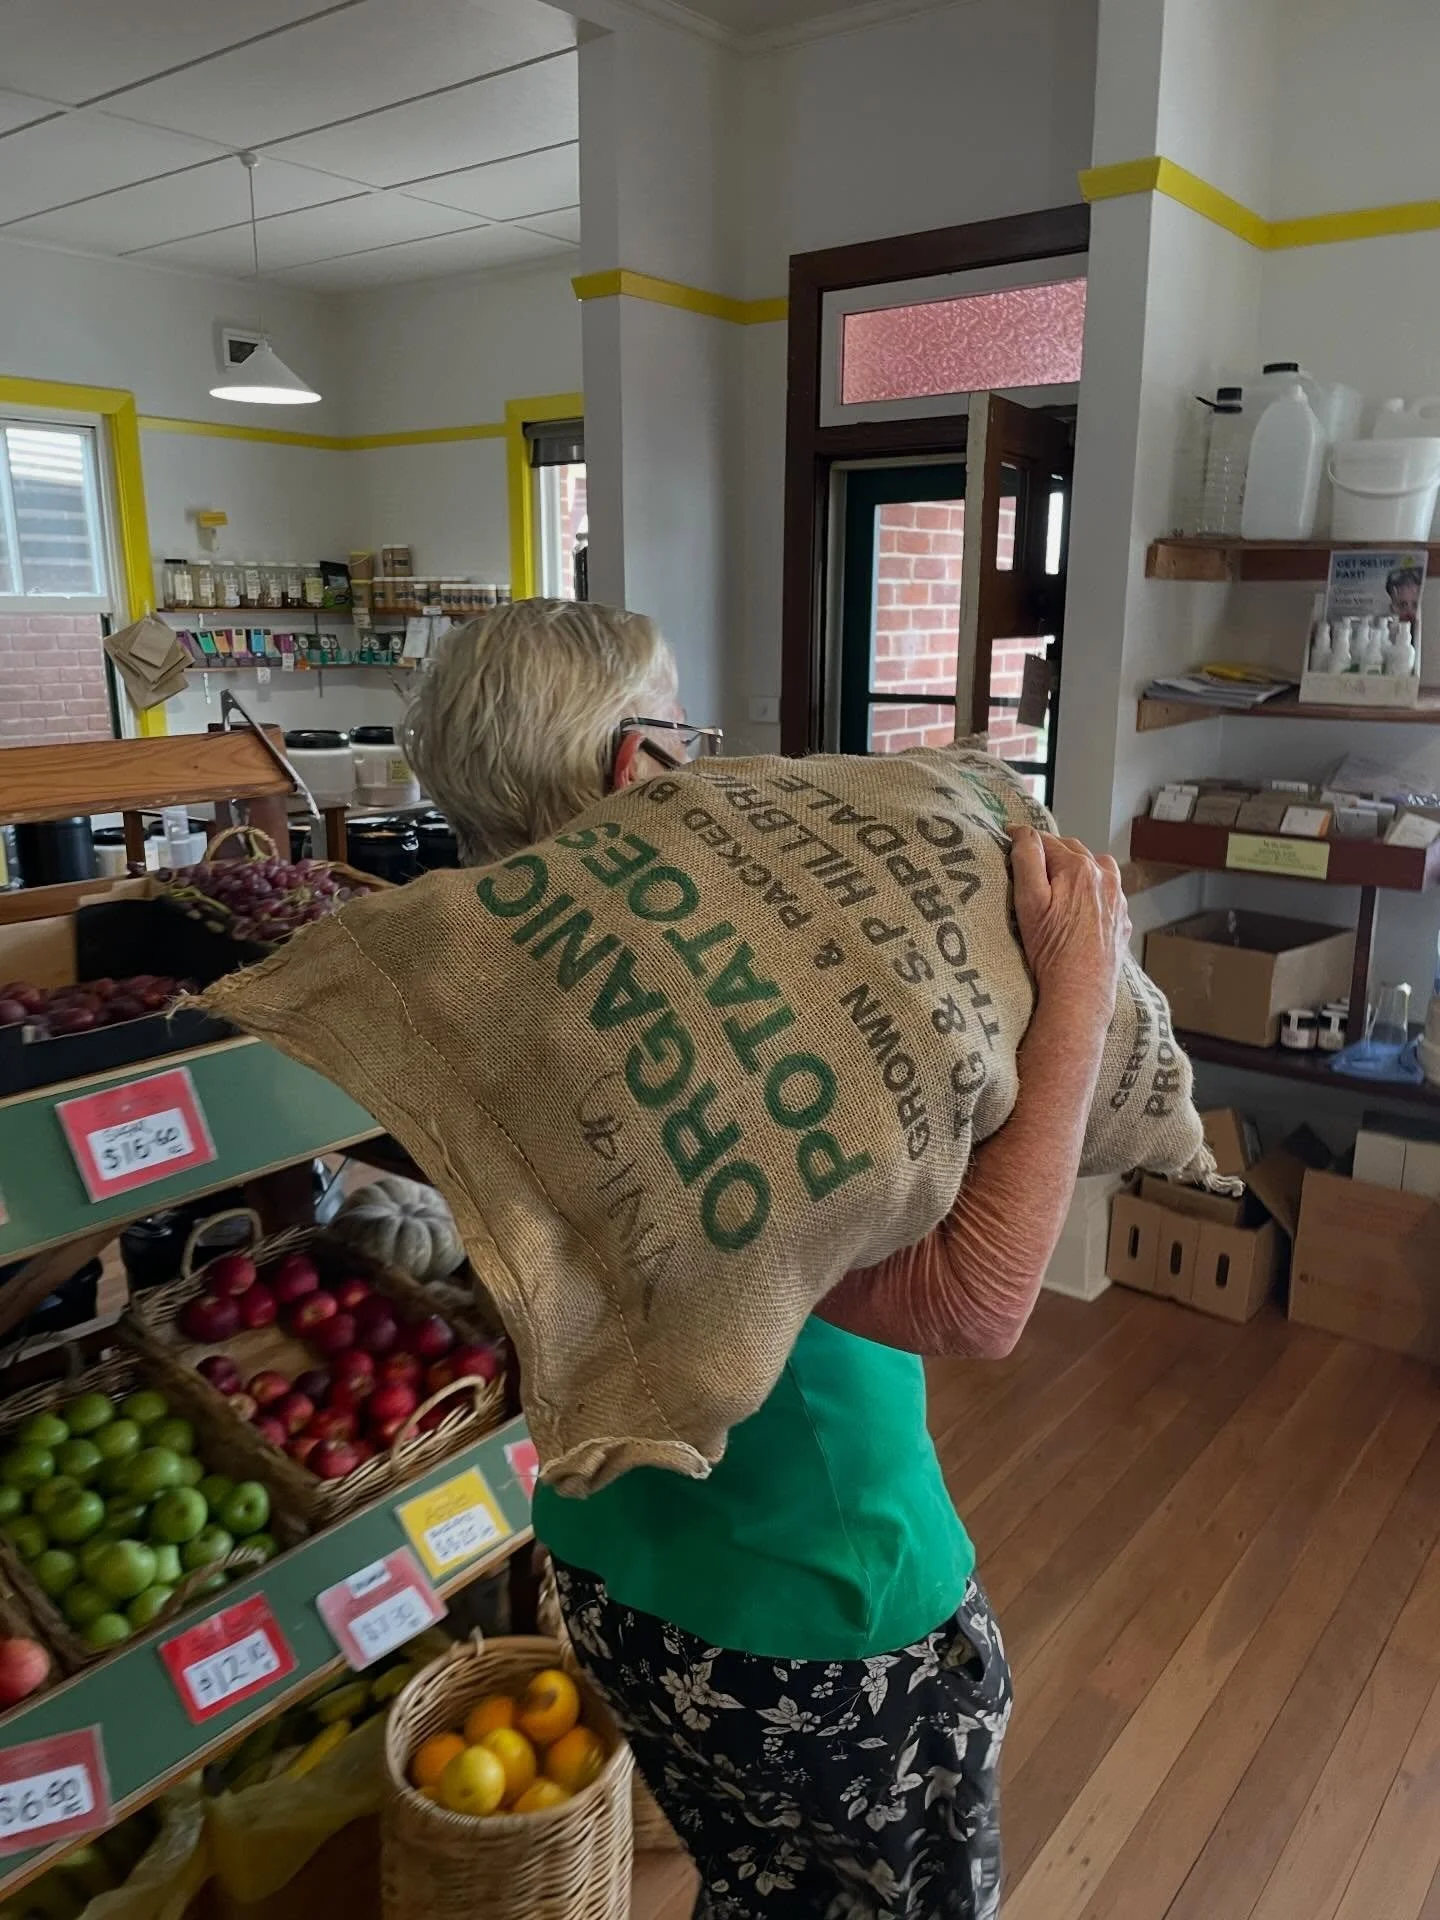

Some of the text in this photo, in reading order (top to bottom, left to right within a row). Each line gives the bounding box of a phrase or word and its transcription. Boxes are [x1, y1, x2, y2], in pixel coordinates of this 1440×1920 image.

[682, 807, 812, 931] PACKED
[766, 774, 1000, 1050] THORPDALE
[916, 815, 982, 904] VIC
[555, 822, 875, 1201] POTATOES
[812, 938, 847, 971] &
[931, 993, 967, 1035] &
[476, 854, 771, 1251] ORGANIC
[838, 982, 931, 1161] GROWN
